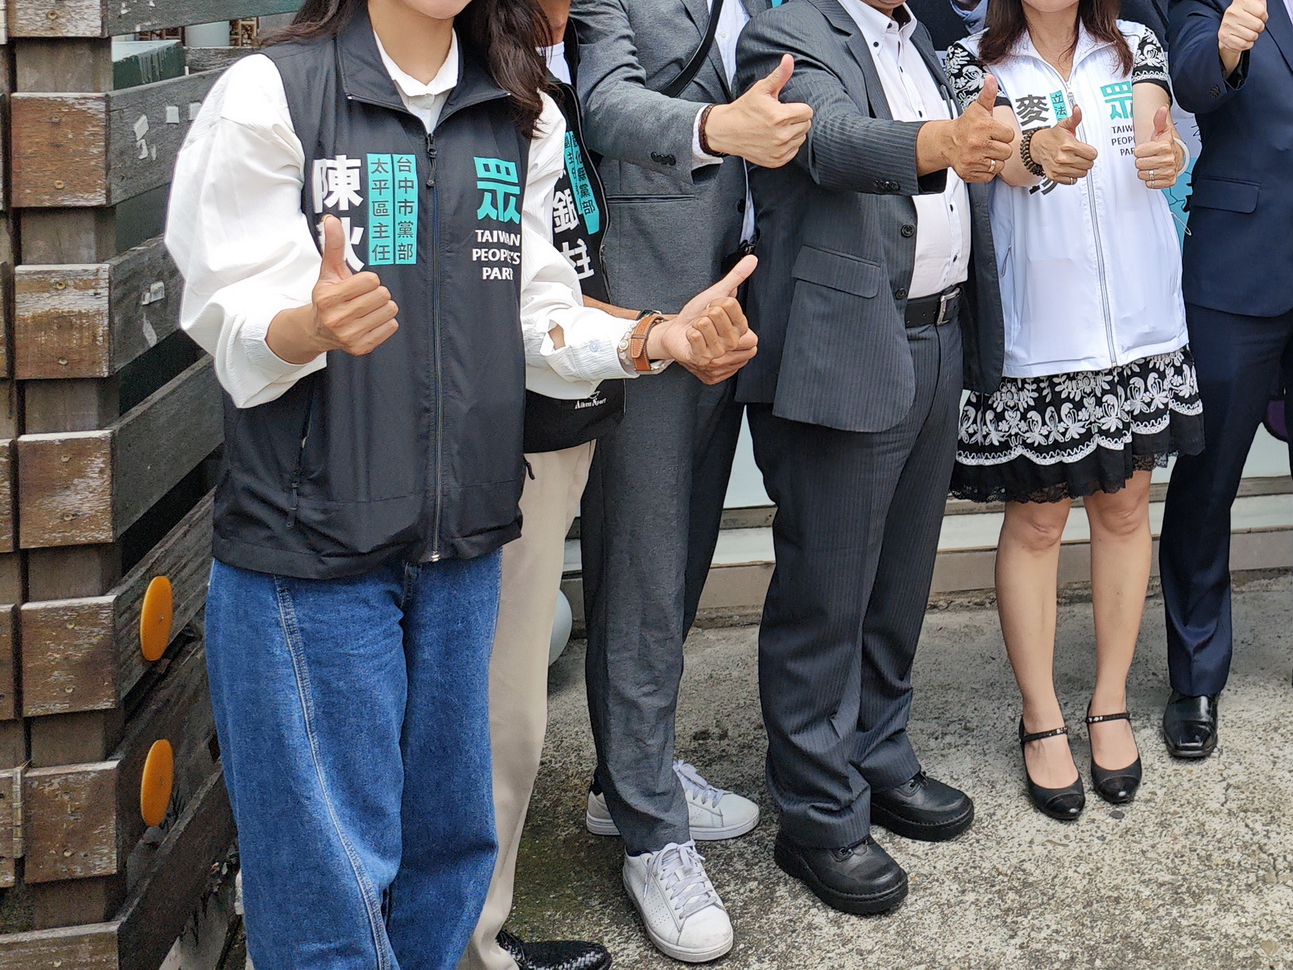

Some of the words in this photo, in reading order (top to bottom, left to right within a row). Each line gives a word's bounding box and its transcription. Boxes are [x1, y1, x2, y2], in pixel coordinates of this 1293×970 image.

[1051, 94, 1067, 119] 立法
[1111, 124, 1133, 134] TAIW
[1111, 135, 1136, 146] PEOP
[371, 157, 391, 262] 太平區主任
[396, 156, 415, 261] 台中市黨部
[473, 156, 521, 225] 眾
